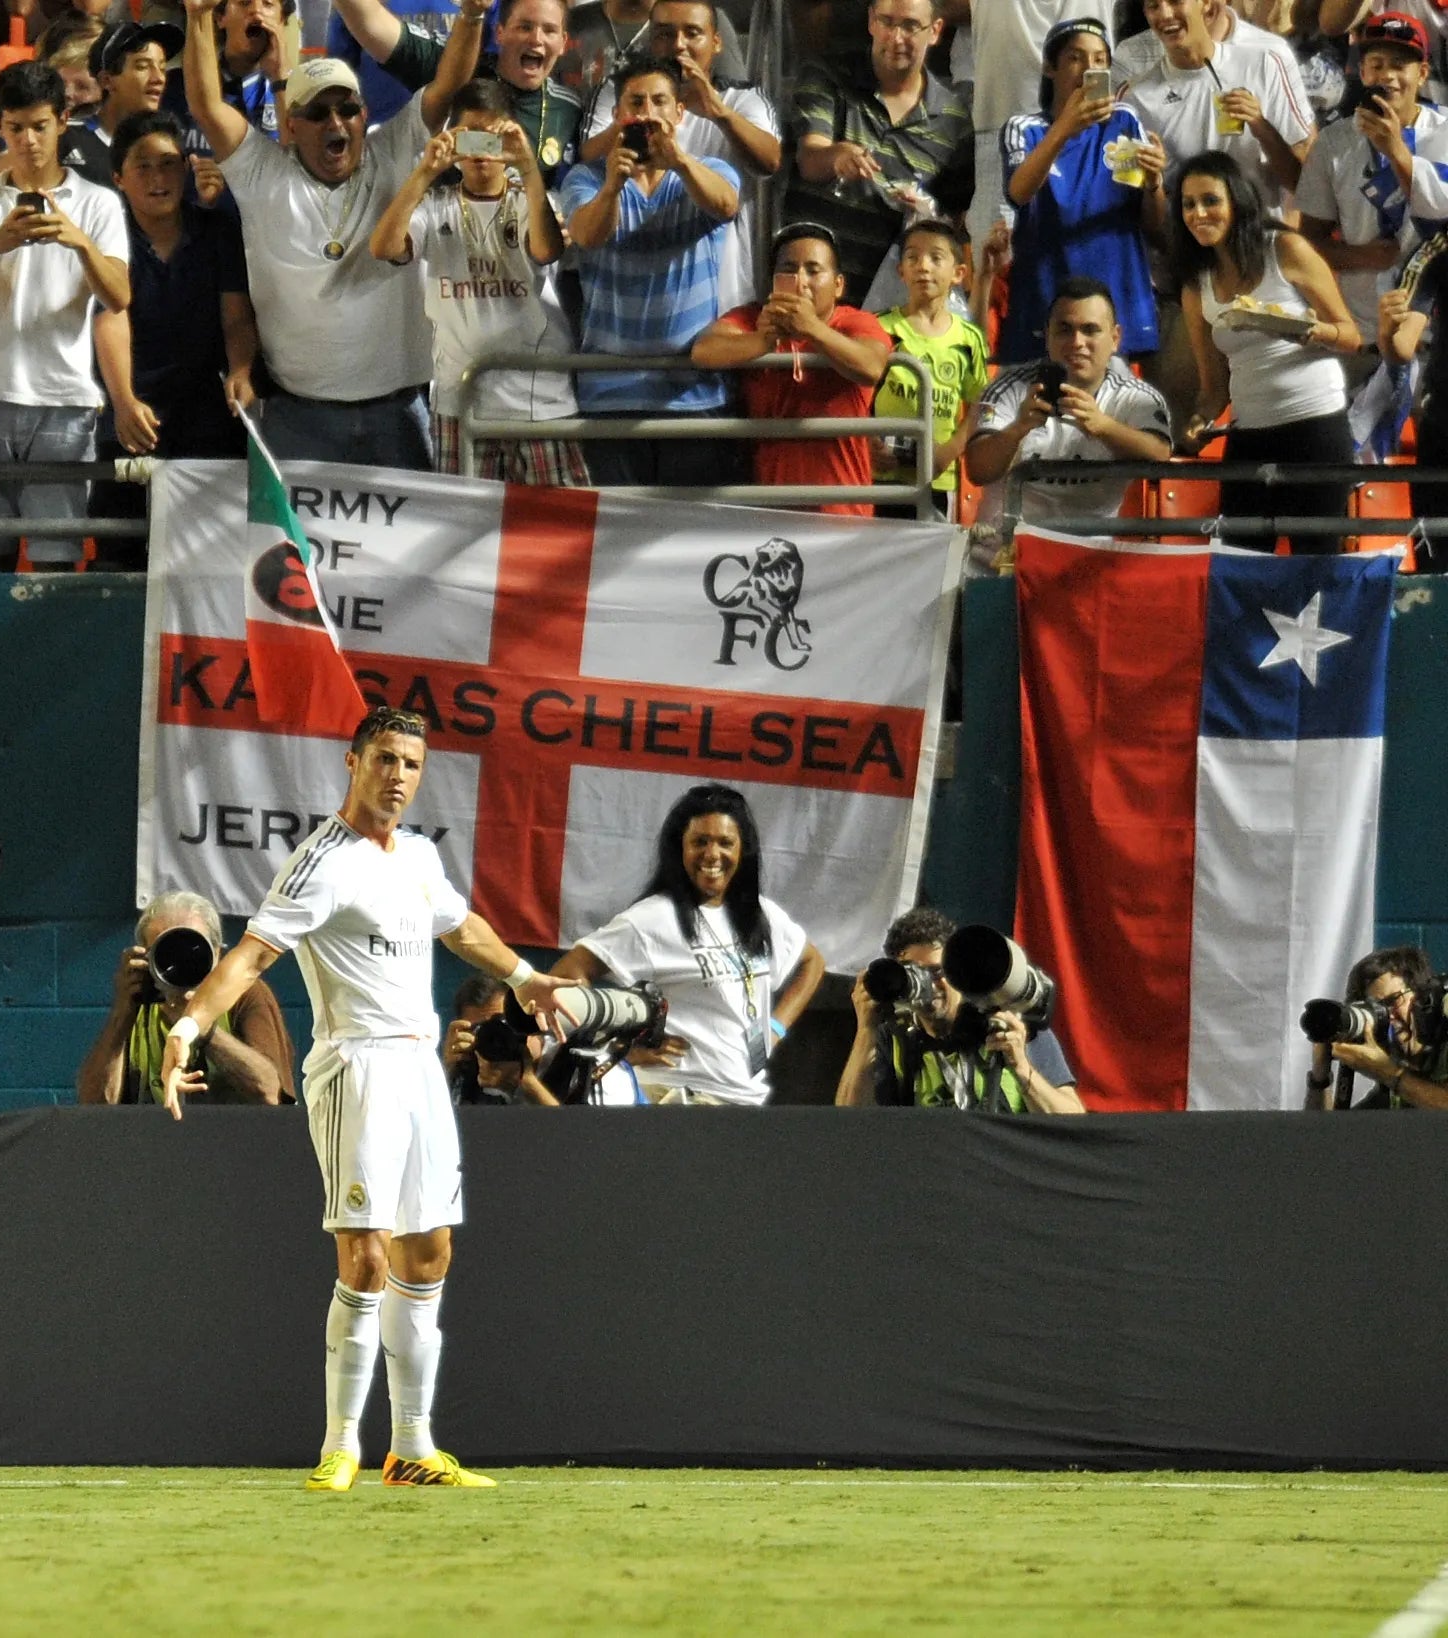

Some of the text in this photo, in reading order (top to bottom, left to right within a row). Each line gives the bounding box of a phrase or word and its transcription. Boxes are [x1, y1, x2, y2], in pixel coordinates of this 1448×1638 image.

[440, 275, 528, 300] Emirates
[290, 484, 409, 527] RMY
[170, 652, 905, 780] KASAS CHELSEA
